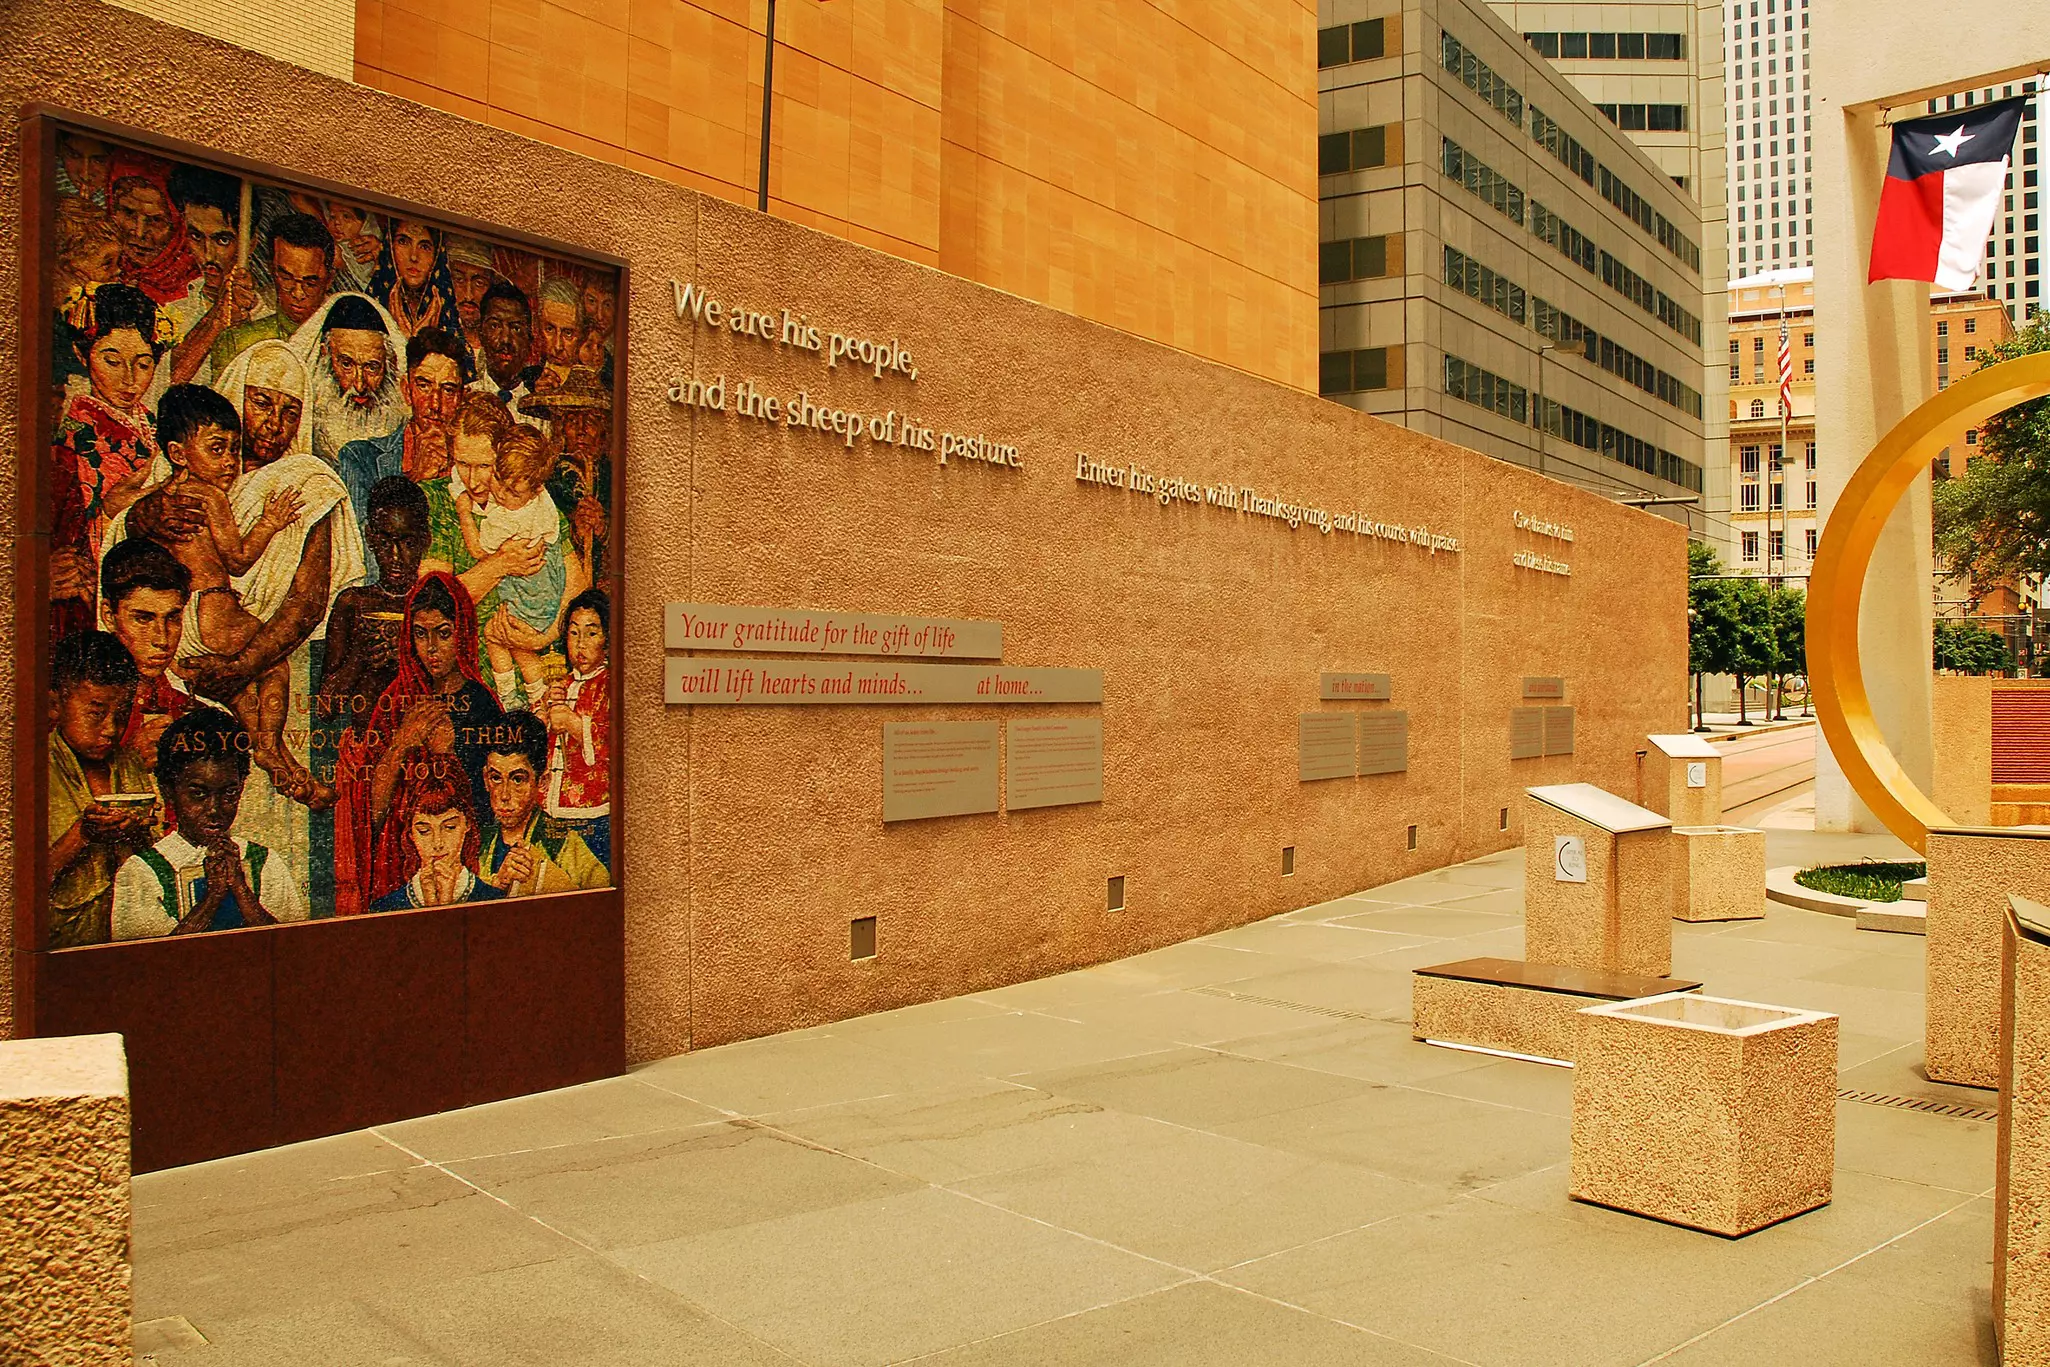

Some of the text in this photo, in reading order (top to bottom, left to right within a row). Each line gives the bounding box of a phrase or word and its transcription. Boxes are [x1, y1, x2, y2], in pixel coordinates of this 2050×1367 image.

[671, 279, 919, 381] We are his people,
[668, 375, 1023, 467] and the sheep of his pasture.
[1075, 451, 1126, 488] Enter
[1129, 461, 1155, 493] his
[1158, 476, 1200, 505] gates
[1204, 482, 1237, 510] with
[1241, 487, 1332, 534] Thanksgiving,
[1333, 510, 1356, 532] and
[1357, 511, 1375, 535] his
[1375, 522, 1408, 543] courts
[1408, 525, 1431, 548] with
[681, 612, 955, 655] Your gratitude for the gift of life
[681, 668, 1043, 702] will lift hearts and minds... at home...
[1332, 679, 1340, 693] in
[1341, 679, 1352, 693] the
[242, 693, 471, 715] DO UNTO OTHERS
[173, 730, 206, 752] AS
[216, 730, 278, 752] YOU
[285, 728, 380, 750] WOULD
[462, 725, 524, 746] THEM
[272, 761, 448, 788] DO UNTO YOU
